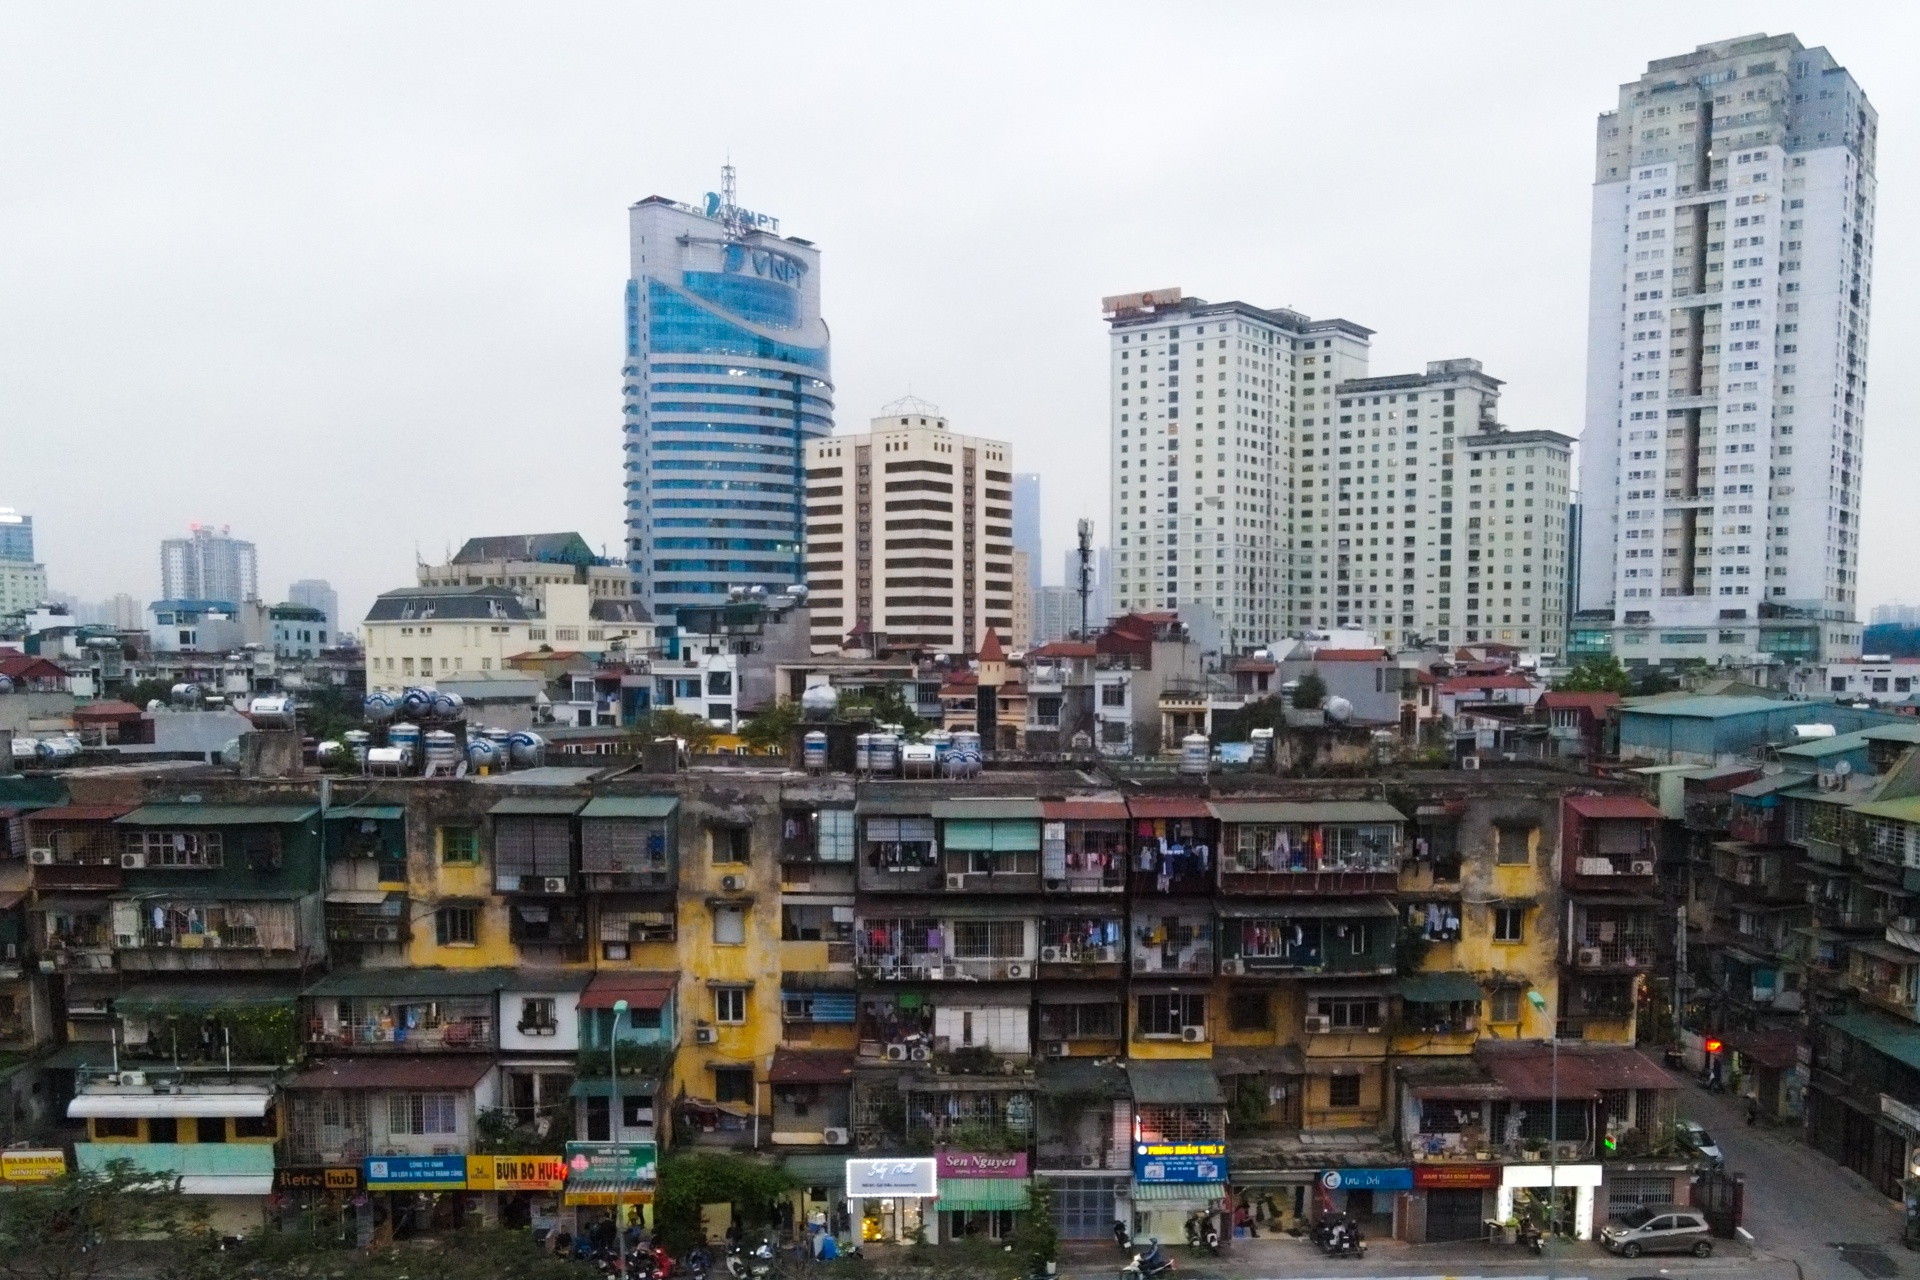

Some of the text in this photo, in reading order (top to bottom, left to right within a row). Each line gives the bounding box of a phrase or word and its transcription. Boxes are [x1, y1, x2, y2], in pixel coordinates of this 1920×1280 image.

[751, 252, 800, 289] VNPT
[521, 1159, 535, 1180] BÒ
[945, 1155, 1017, 1169] Sen Nguyen
[327, 1172, 355, 1185] hub
